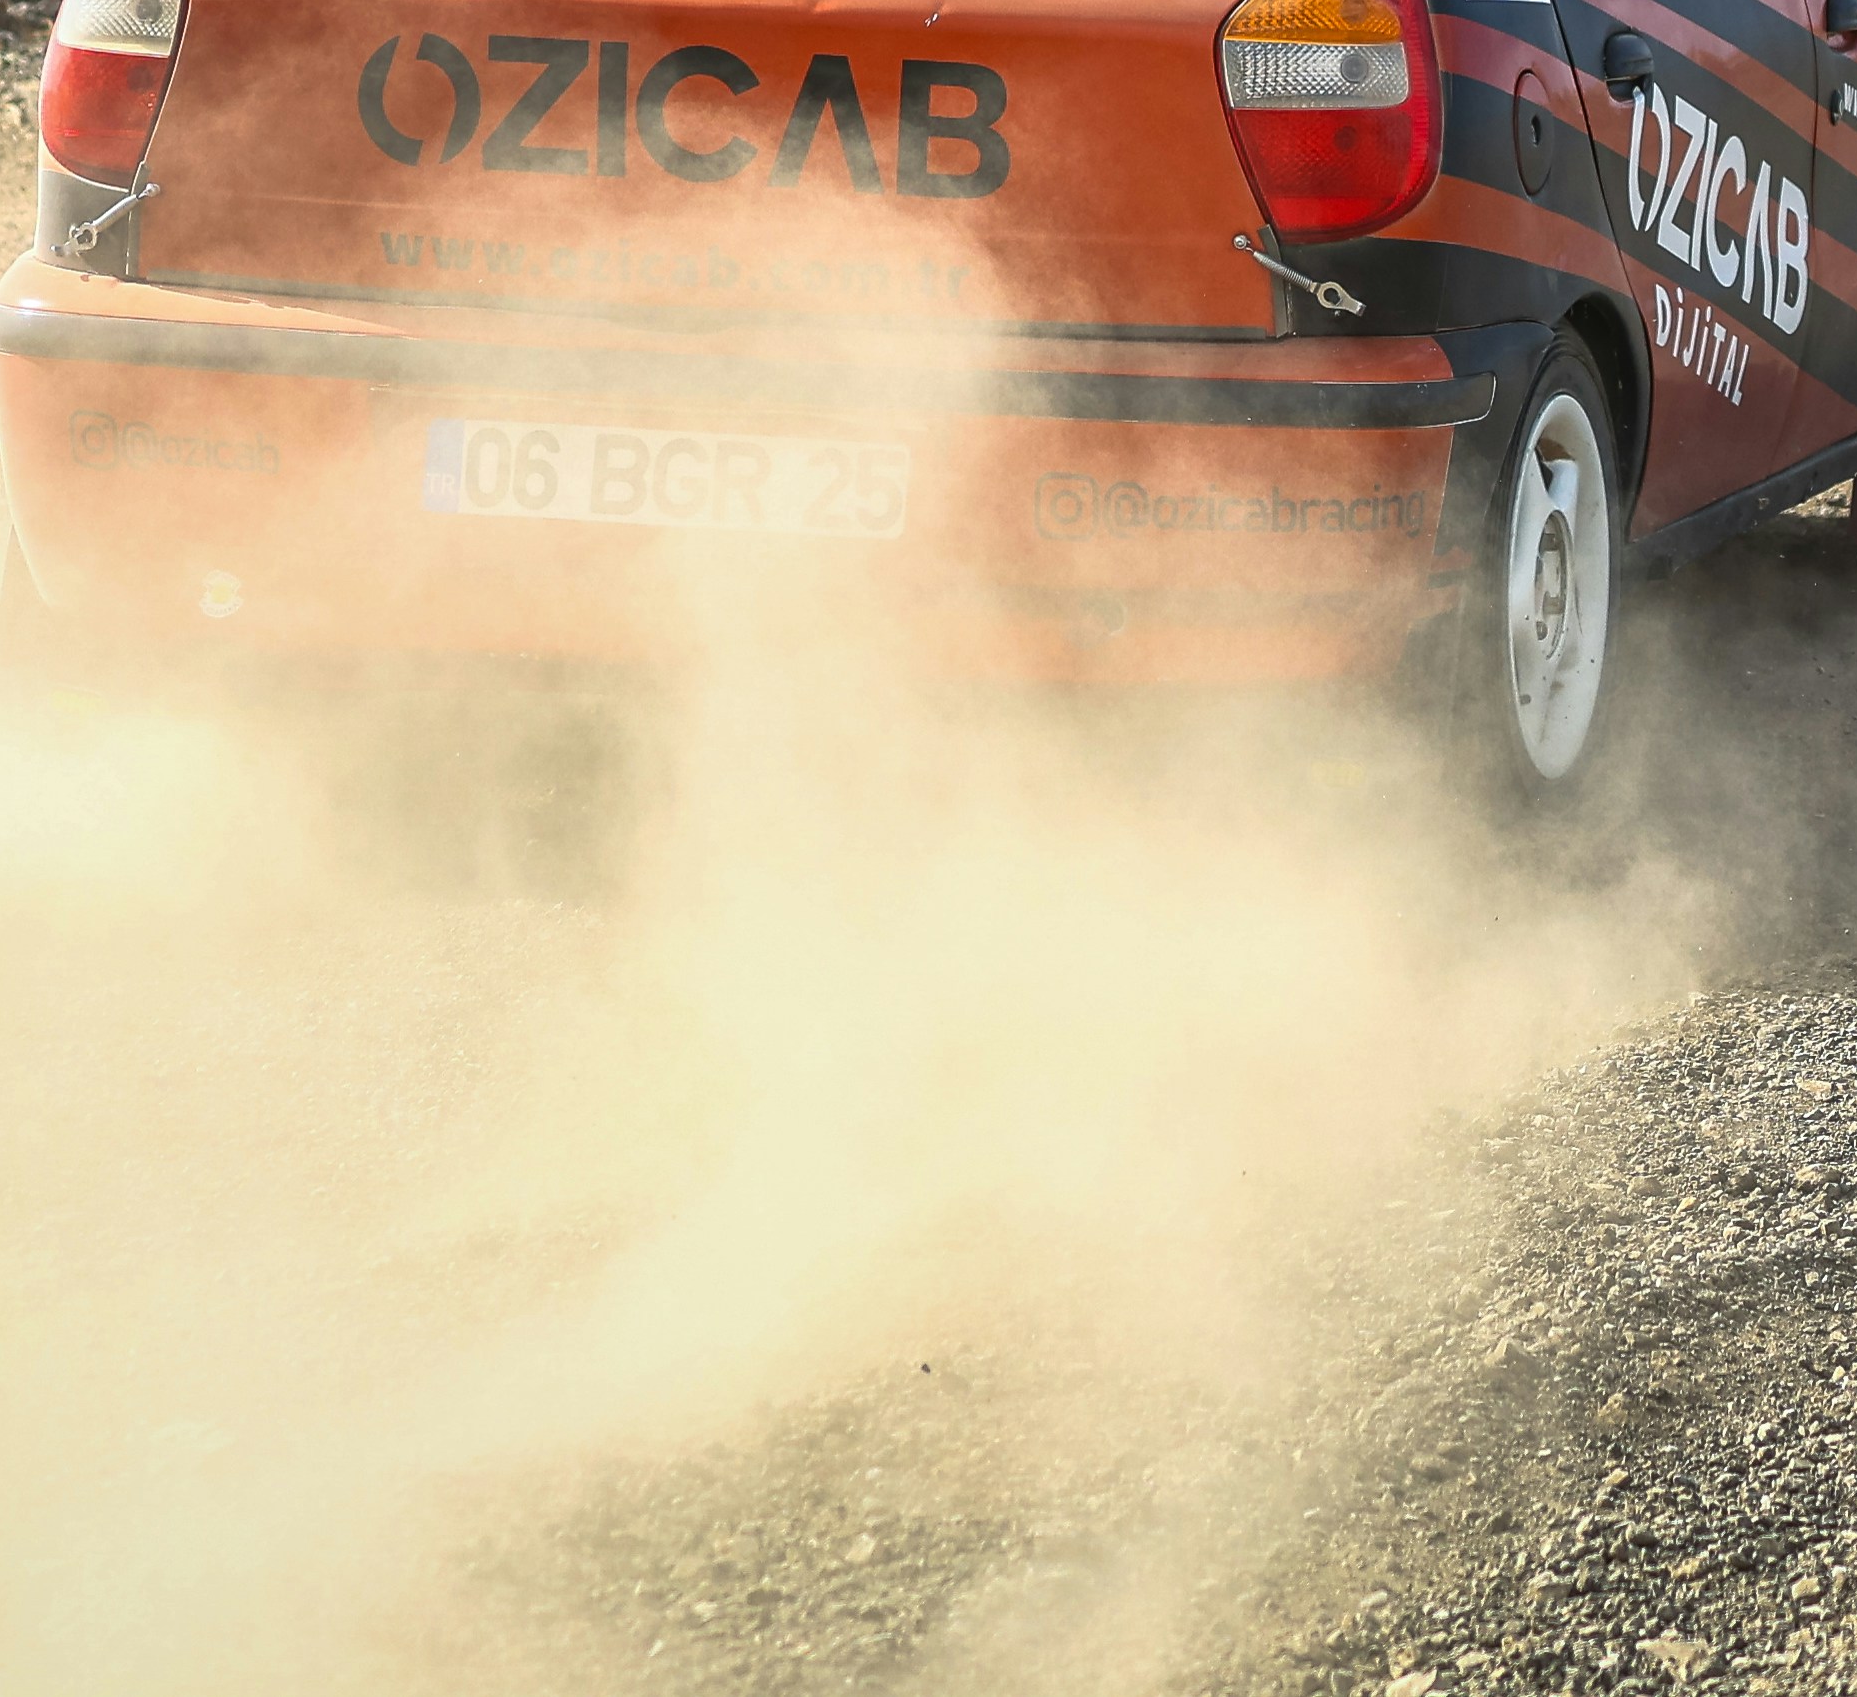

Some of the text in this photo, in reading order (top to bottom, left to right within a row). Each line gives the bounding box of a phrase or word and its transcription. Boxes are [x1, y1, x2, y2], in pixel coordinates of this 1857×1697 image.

[357, 31, 1012, 200] OZICAB
[1628, 82, 1809, 335] OZICAB
[425, 472, 458, 496] TR
[464, 426, 904, 532] 06 BGR 25
[1103, 480, 1425, 539] @ozicabracing
